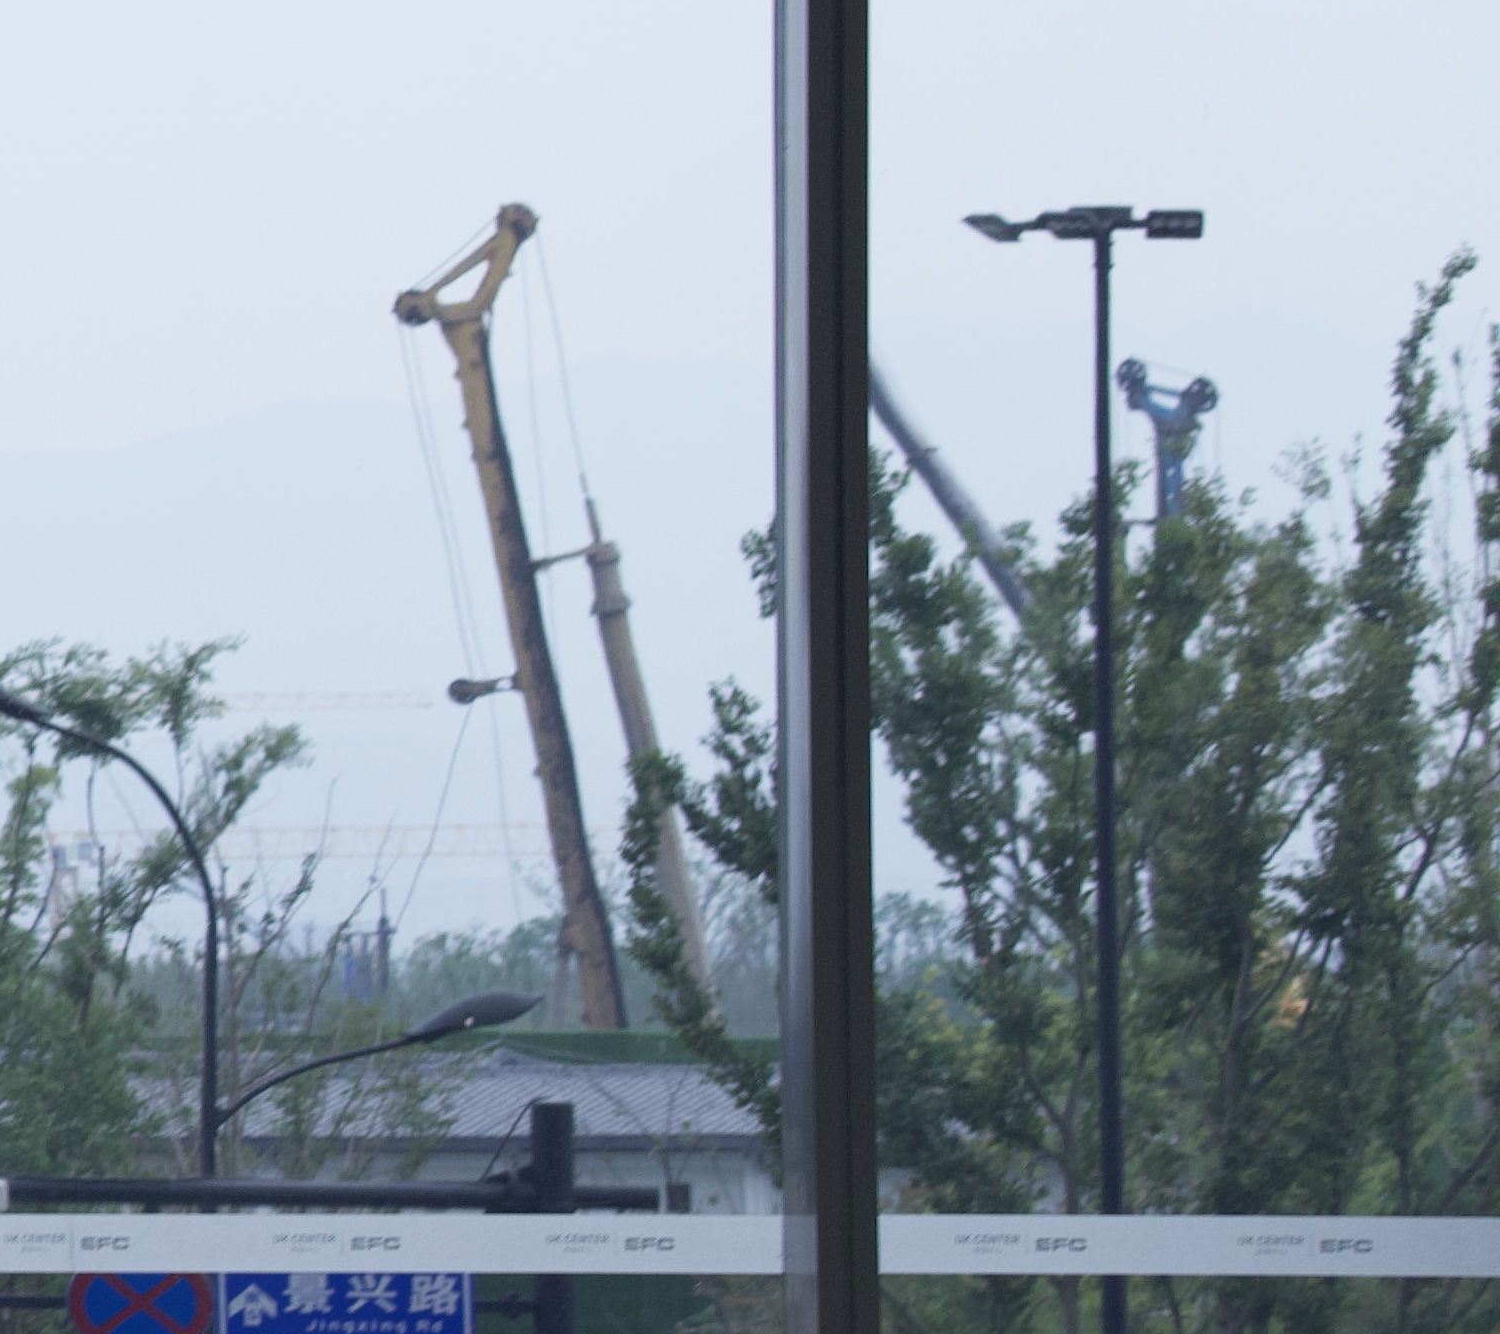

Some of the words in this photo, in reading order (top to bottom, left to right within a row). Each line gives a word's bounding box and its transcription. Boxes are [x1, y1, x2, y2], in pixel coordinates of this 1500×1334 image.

[80, 1236, 130, 1251] EFC
[350, 1236, 401, 1251] EFC
[624, 1236, 675, 1252] EFC
[1035, 1237, 1088, 1253] EFC
[1319, 1238, 1373, 1254] EFC
